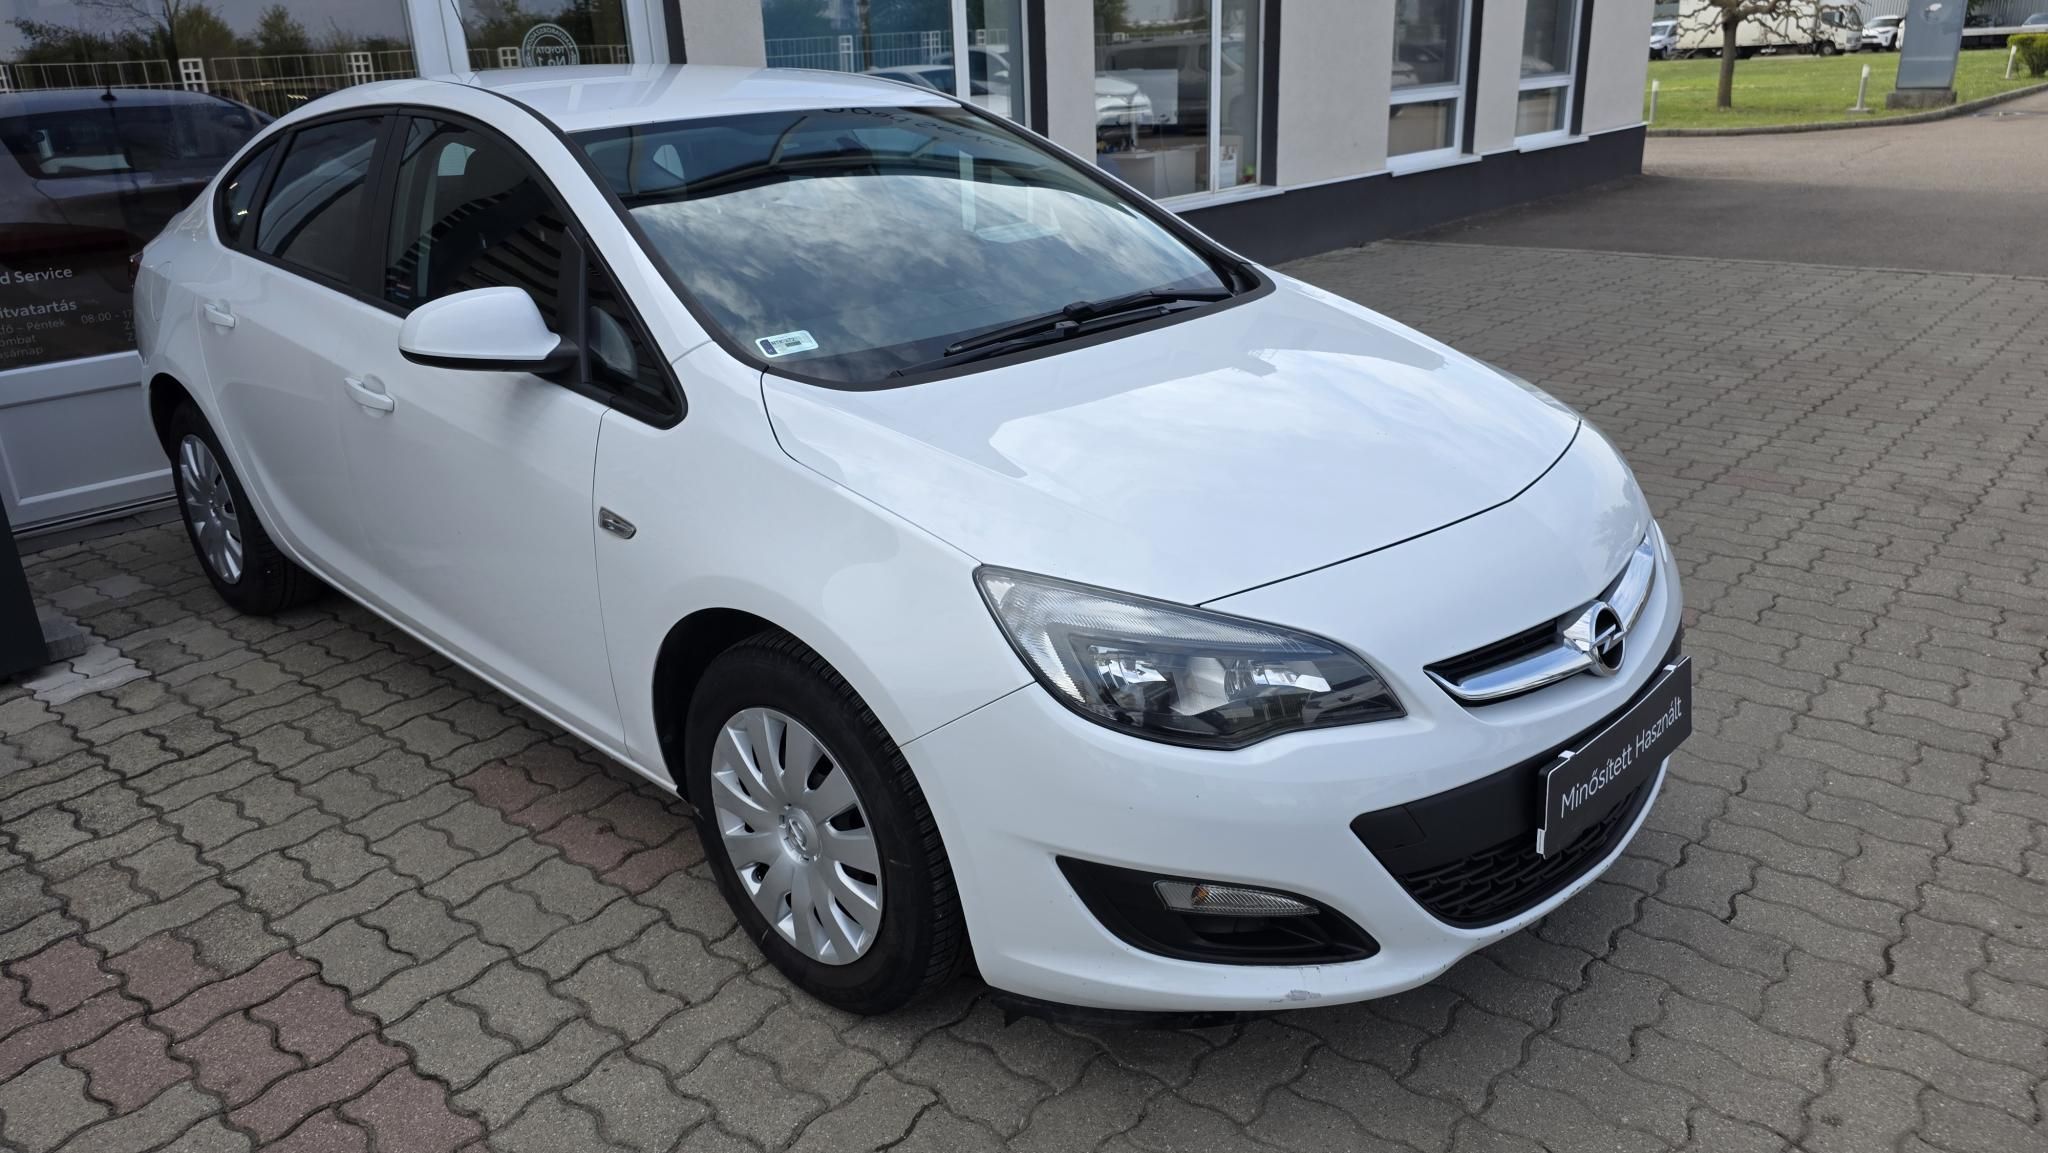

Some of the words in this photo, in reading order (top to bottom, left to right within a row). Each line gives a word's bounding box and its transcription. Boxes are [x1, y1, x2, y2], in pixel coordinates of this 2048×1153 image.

[14, 267, 73, 283] Service
[26, 318, 66, 331] Péntek
[1561, 744, 1632, 819] Minősített
[1635, 697, 1682, 758] Használt
